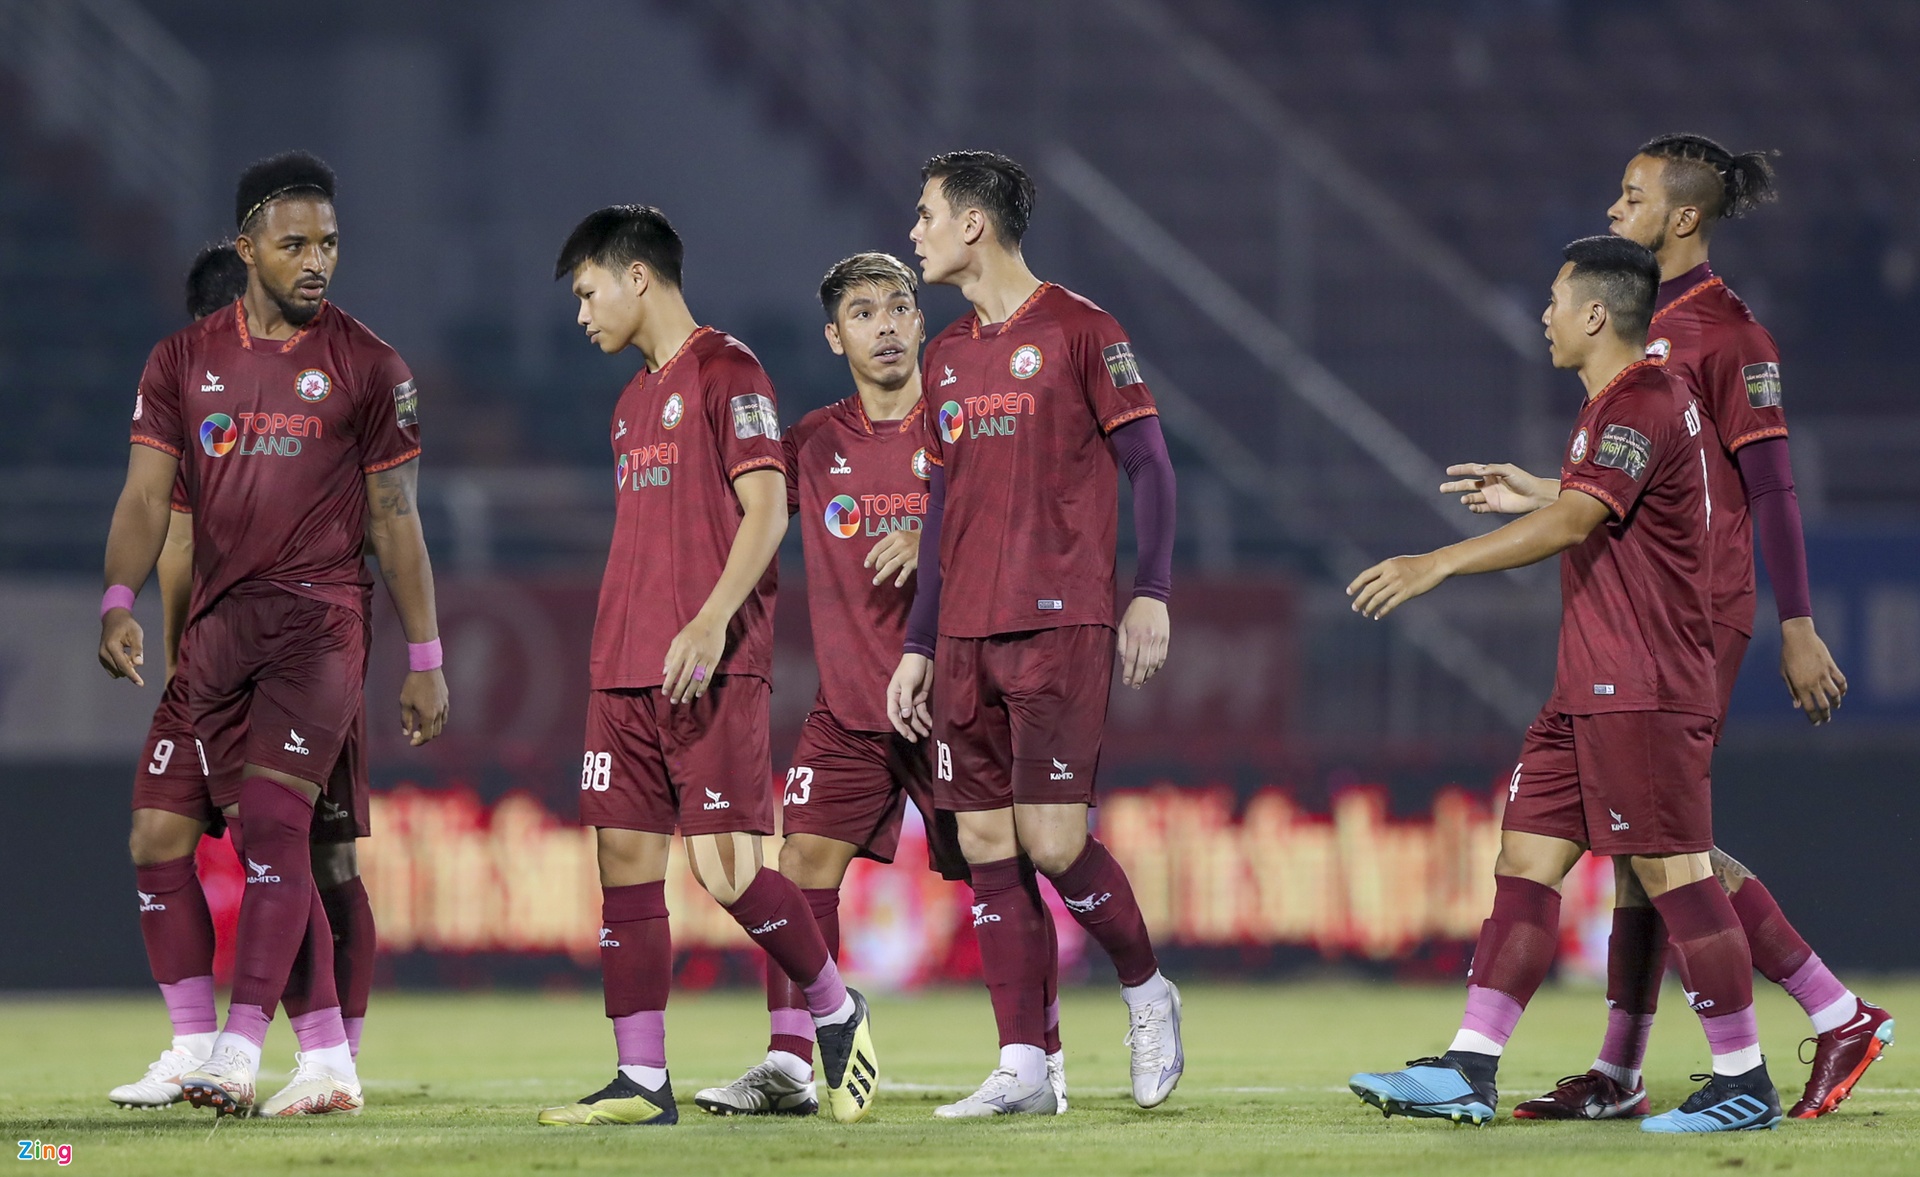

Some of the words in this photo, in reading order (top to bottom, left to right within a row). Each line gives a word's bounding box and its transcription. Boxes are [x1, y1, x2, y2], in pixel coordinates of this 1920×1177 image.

[201, 384, 225, 392] KAMITO
[964, 392, 1035, 419] TOPEN
[239, 412, 322, 439] TOPEN
[969, 415, 1017, 440] LAND
[239, 435, 302, 456] LAND
[632, 466, 671, 491] LAND
[829, 466, 852, 474] KAMITO
[149, 739, 174, 775] 9
[284, 742, 309, 755] KAMITO
[936, 739, 953, 782] 19
[581, 751, 612, 792] 88
[1050, 772, 1074, 780] KAMITO
[783, 766, 814, 806] 23
[703, 800, 730, 810] KAMITO
